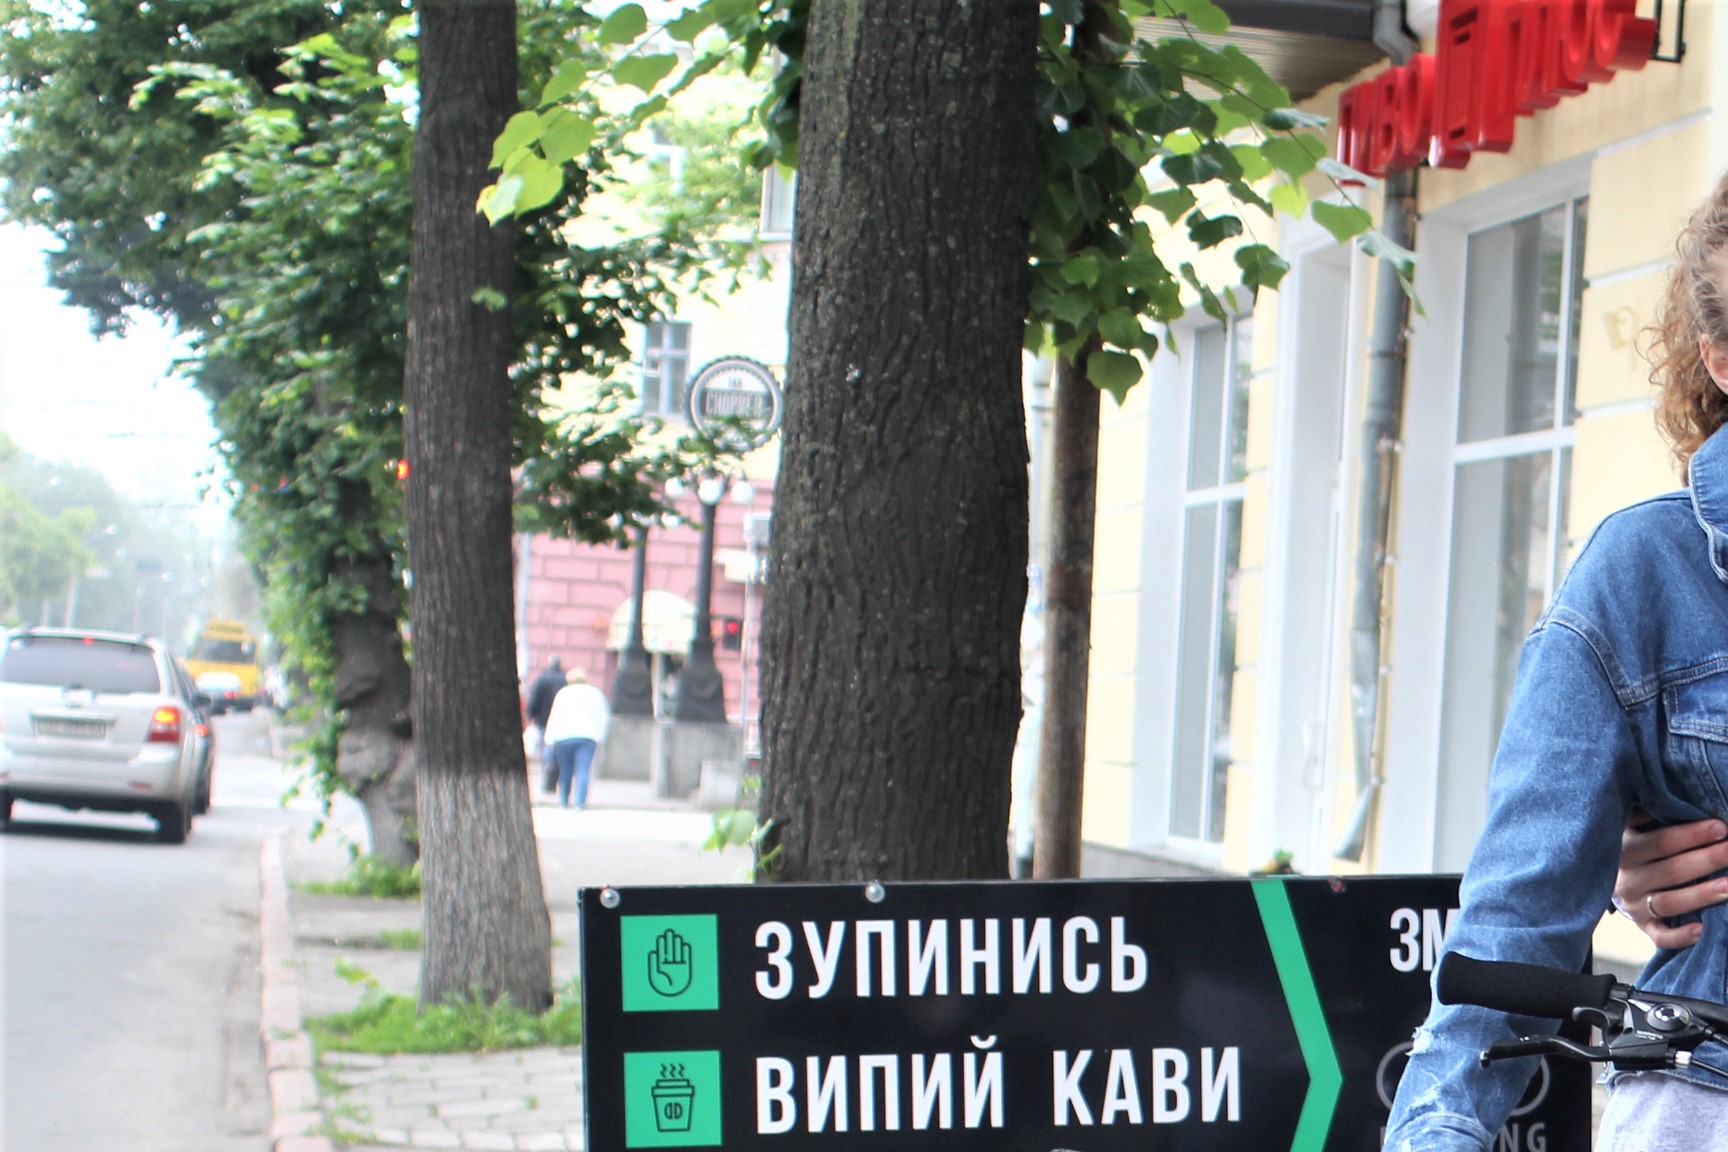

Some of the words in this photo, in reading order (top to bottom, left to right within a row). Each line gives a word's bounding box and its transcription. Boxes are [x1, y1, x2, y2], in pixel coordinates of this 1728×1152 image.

[755, 915, 1147, 1000] ЗУПИНИСЬ
[1389, 907, 1461, 972] ЗМ
[756, 1034, 1004, 1135] ВИПИЙ
[1053, 1046, 1240, 1126] КАВИ
